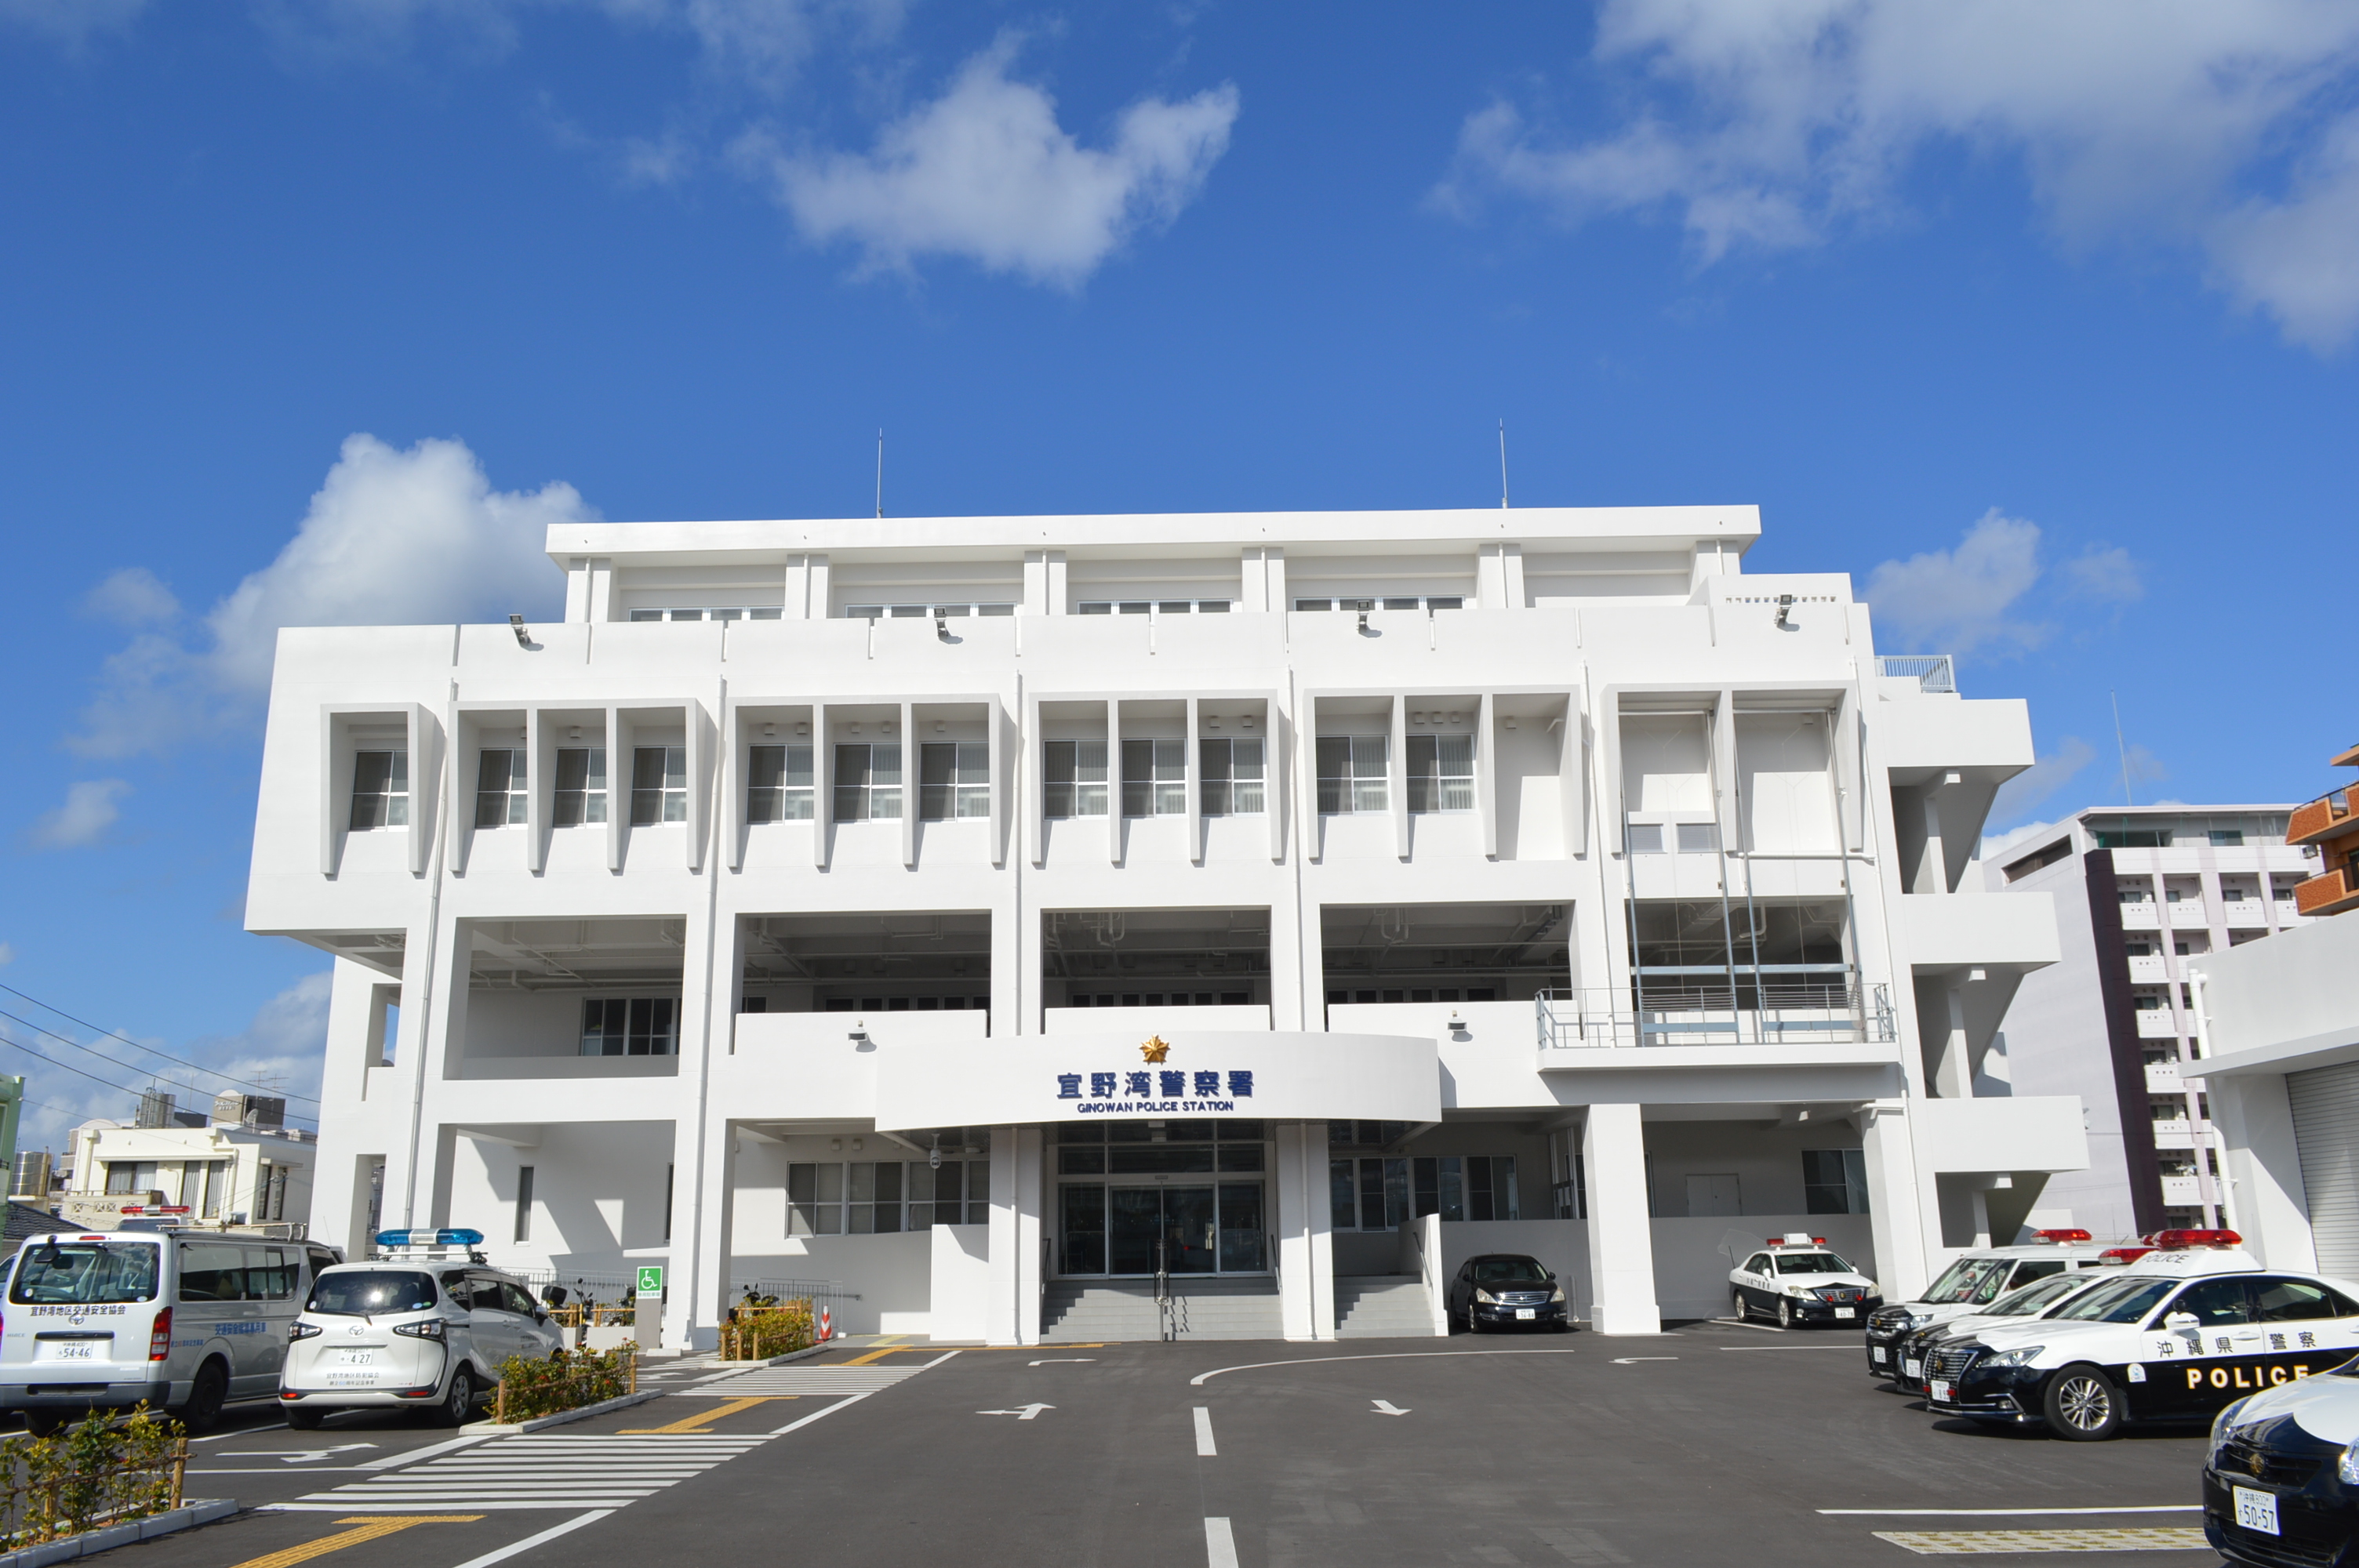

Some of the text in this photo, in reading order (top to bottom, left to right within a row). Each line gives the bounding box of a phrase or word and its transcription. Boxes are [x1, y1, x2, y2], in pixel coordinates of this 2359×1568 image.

[1057, 1070, 1254, 1099] 宜野湾警察署
[1077, 1101, 1234, 1113] GINOWAN POLICE STATION
[2139, 1254, 2190, 1264] POLICE
[30, 1305, 126, 1316] 宜野湾地区交通安全協会
[63, 1348, 90, 1358] 54-46
[2157, 1330, 2316, 1358] 沖縄県警察
[2186, 1365, 2310, 1389] POLICE
[2244, 1504, 2274, 1530] 50-57
